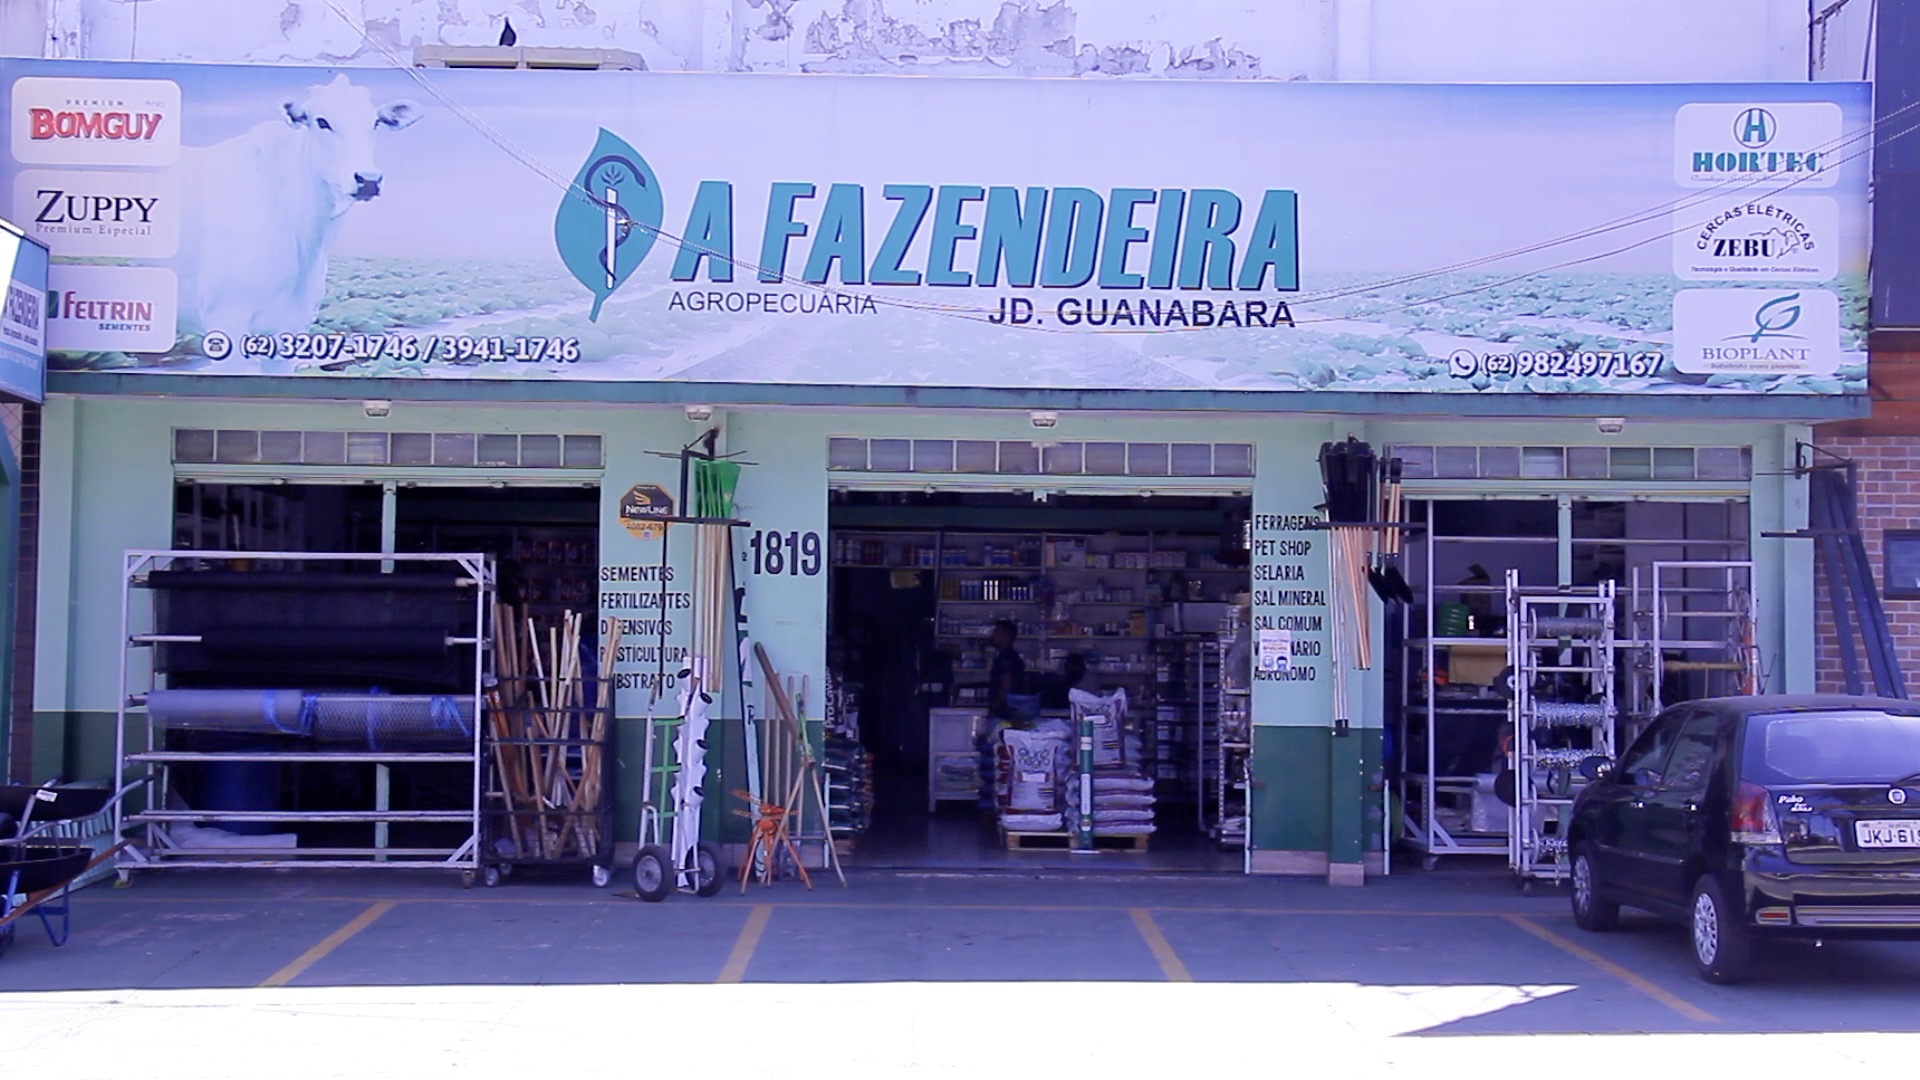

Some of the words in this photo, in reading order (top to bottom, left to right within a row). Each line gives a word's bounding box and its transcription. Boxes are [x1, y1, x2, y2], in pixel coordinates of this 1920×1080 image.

[65, 98, 125, 106] PREMIUM
[1692, 152, 1825, 173] HORTEC
[35, 190, 159, 223] ZUPPY
[36, 223, 92, 235] Premium
[98, 224, 152, 237] Especial
[669, 181, 734, 283] A
[757, 182, 1300, 292] FAZENDEIRA
[1696, 206, 1743, 251] CERCAS
[1747, 203, 1815, 250] ELÉTRICAS
[1713, 238, 1776, 258] ZEBU
[988, 297, 1043, 325] JD.
[1057, 298, 1297, 328] GUANABARA
[98, 322, 151, 333] SEMENTES
[240, 335, 275, 357] (62)
[280, 333, 418, 361] 3207-1746
[442, 336, 581, 363] 3941-1746
[1702, 347, 1811, 360] BIOPLANT
[1481, 352, 1516, 376] (62)
[1519, 350, 1664, 378] 982497167
[750, 530, 822, 576] 1819
[1254, 540, 1276, 557] PET
[1279, 540, 1312, 556] SHOP
[1254, 564, 1305, 581] SELARIA
[1254, 590, 1276, 606] SAL
[1278, 590, 1326, 606] MINERAL
[1254, 615, 1275, 631] SAL
[1278, 615, 1322, 632] COMUM
